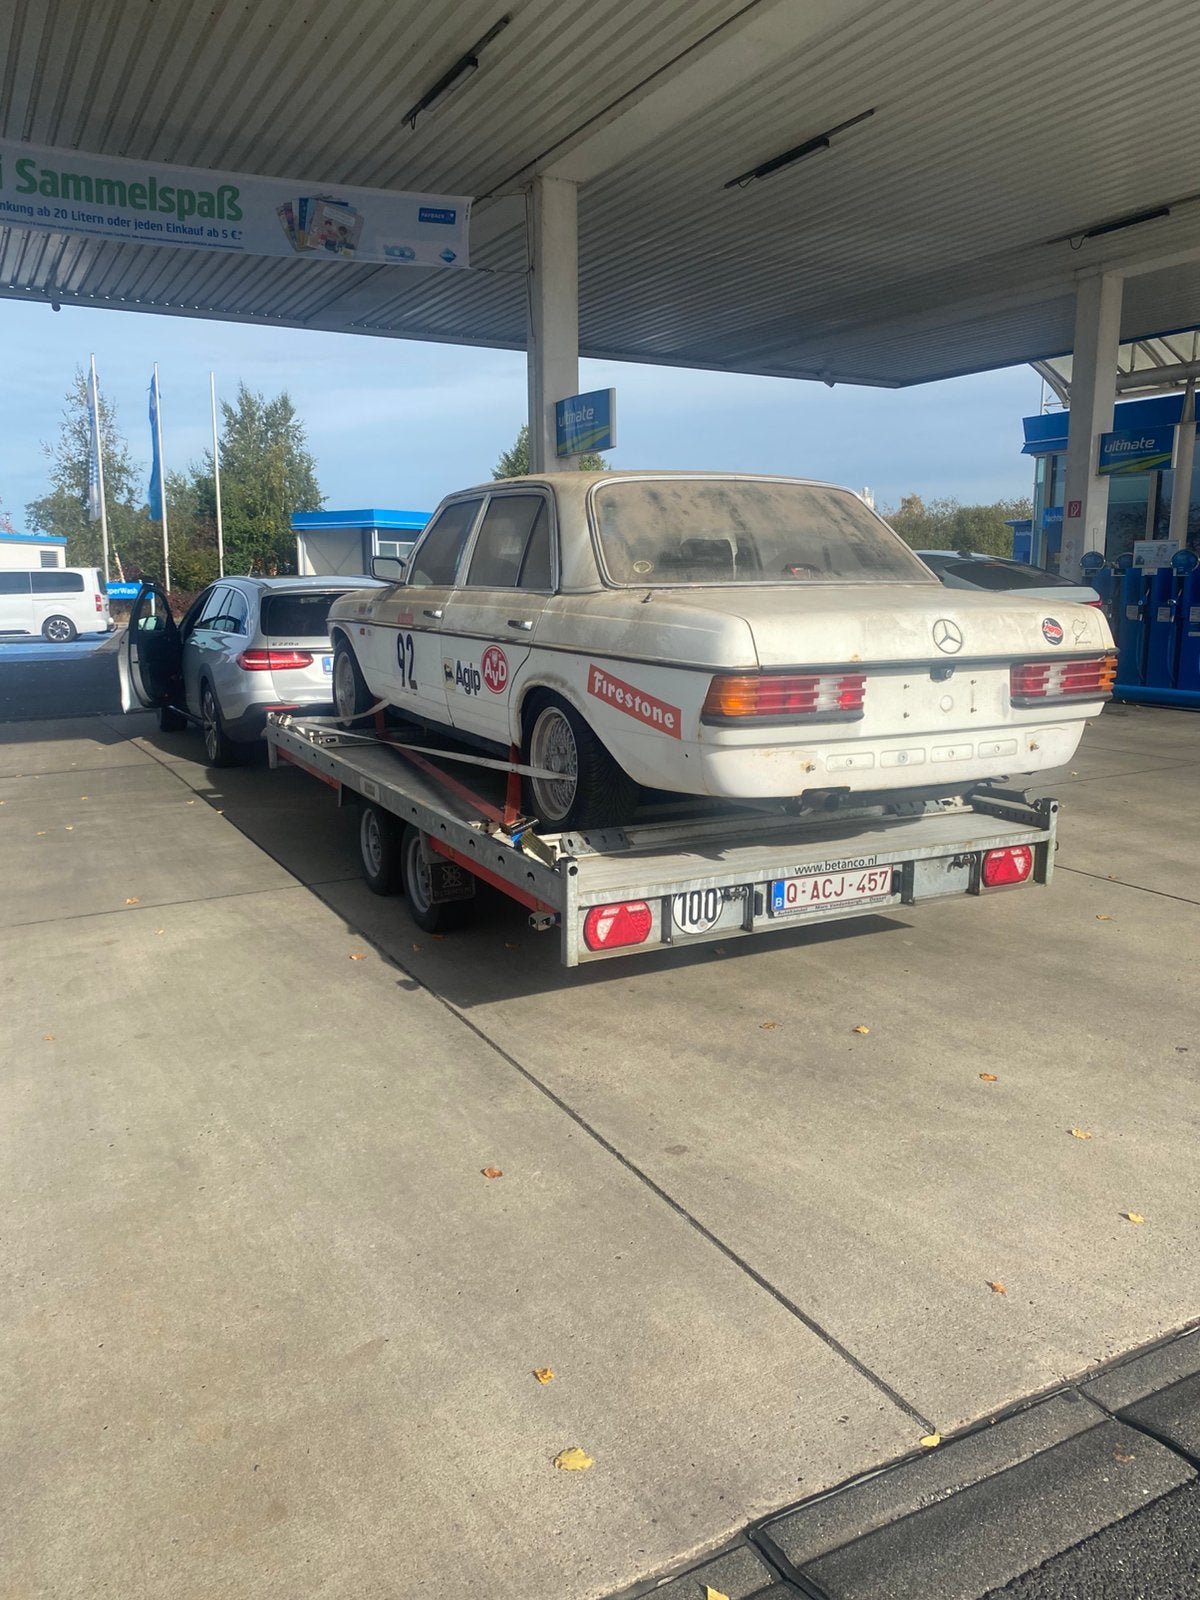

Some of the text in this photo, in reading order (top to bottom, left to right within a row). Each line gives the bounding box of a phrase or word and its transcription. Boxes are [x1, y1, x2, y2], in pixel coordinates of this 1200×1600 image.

[15, 158, 243, 222] Sammelspaß
[37, 206, 51, 217] ab
[54, 207, 68, 219] 20
[72, 210, 104, 224] Litern
[107, 217, 132, 228] oder
[134, 218, 163, 231] jeden
[166, 222, 204, 236] Einkauf
[207, 228, 219, 239] ab
[222, 229, 229, 239] 5
[558, 405, 594, 427] ultimate
[1104, 437, 1156, 453] ultimate
[397, 632, 418, 691] 92
[455, 660, 481, 696] Agip
[593, 671, 675, 729] Firestone
[794, 855, 878, 875] www.betanco.nl
[677, 887, 718, 927] 100
[775, 897, 784, 908] B
